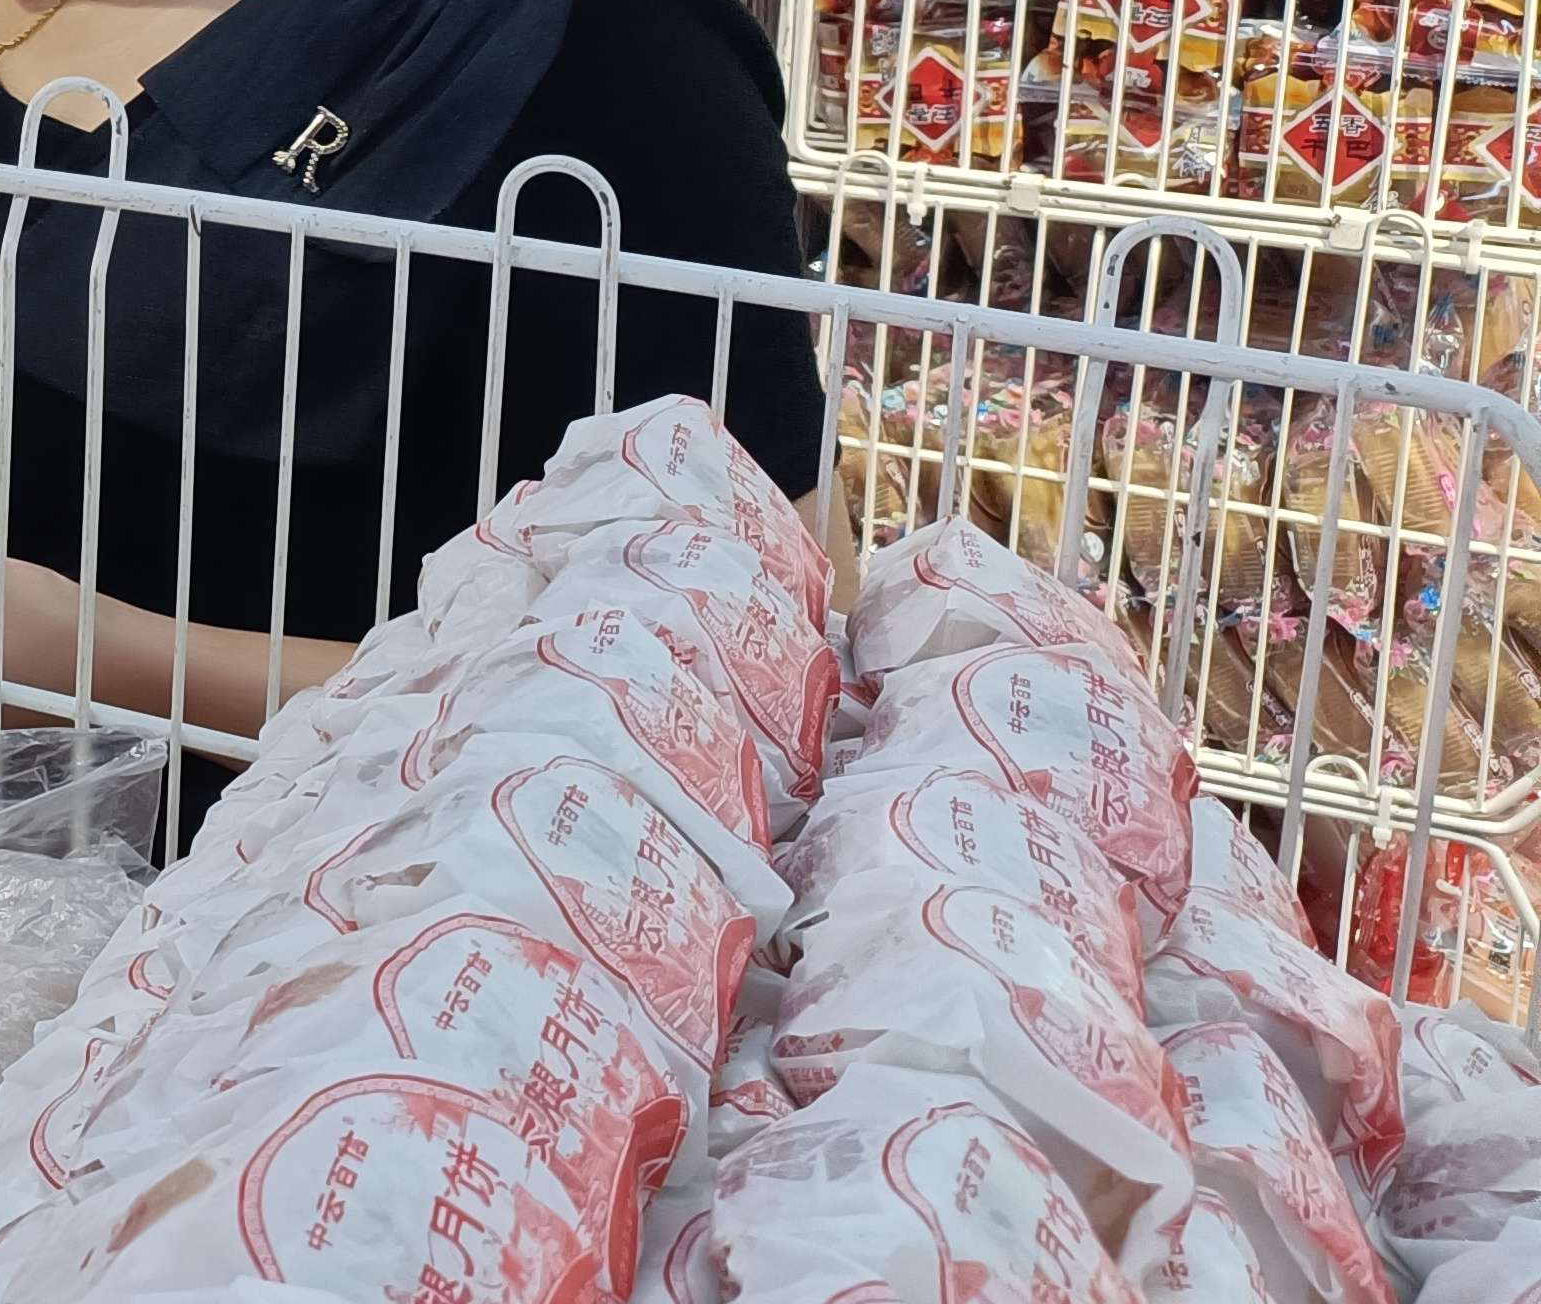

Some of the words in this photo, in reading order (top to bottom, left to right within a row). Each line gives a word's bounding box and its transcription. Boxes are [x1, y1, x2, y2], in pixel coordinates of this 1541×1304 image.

[1308, 113, 1368, 137] 五香
[1007, 672, 1032, 736] 中云百信
[1082, 672, 1131, 827] 云腿月饼
[546, 783, 591, 848] 中云百信
[623, 806, 683, 956] 云腿月饼
[434, 949, 494, 1032] 中云百信
[520, 982, 611, 1164] 云腿月饼
[304, 1129, 370, 1252] 中云百信
